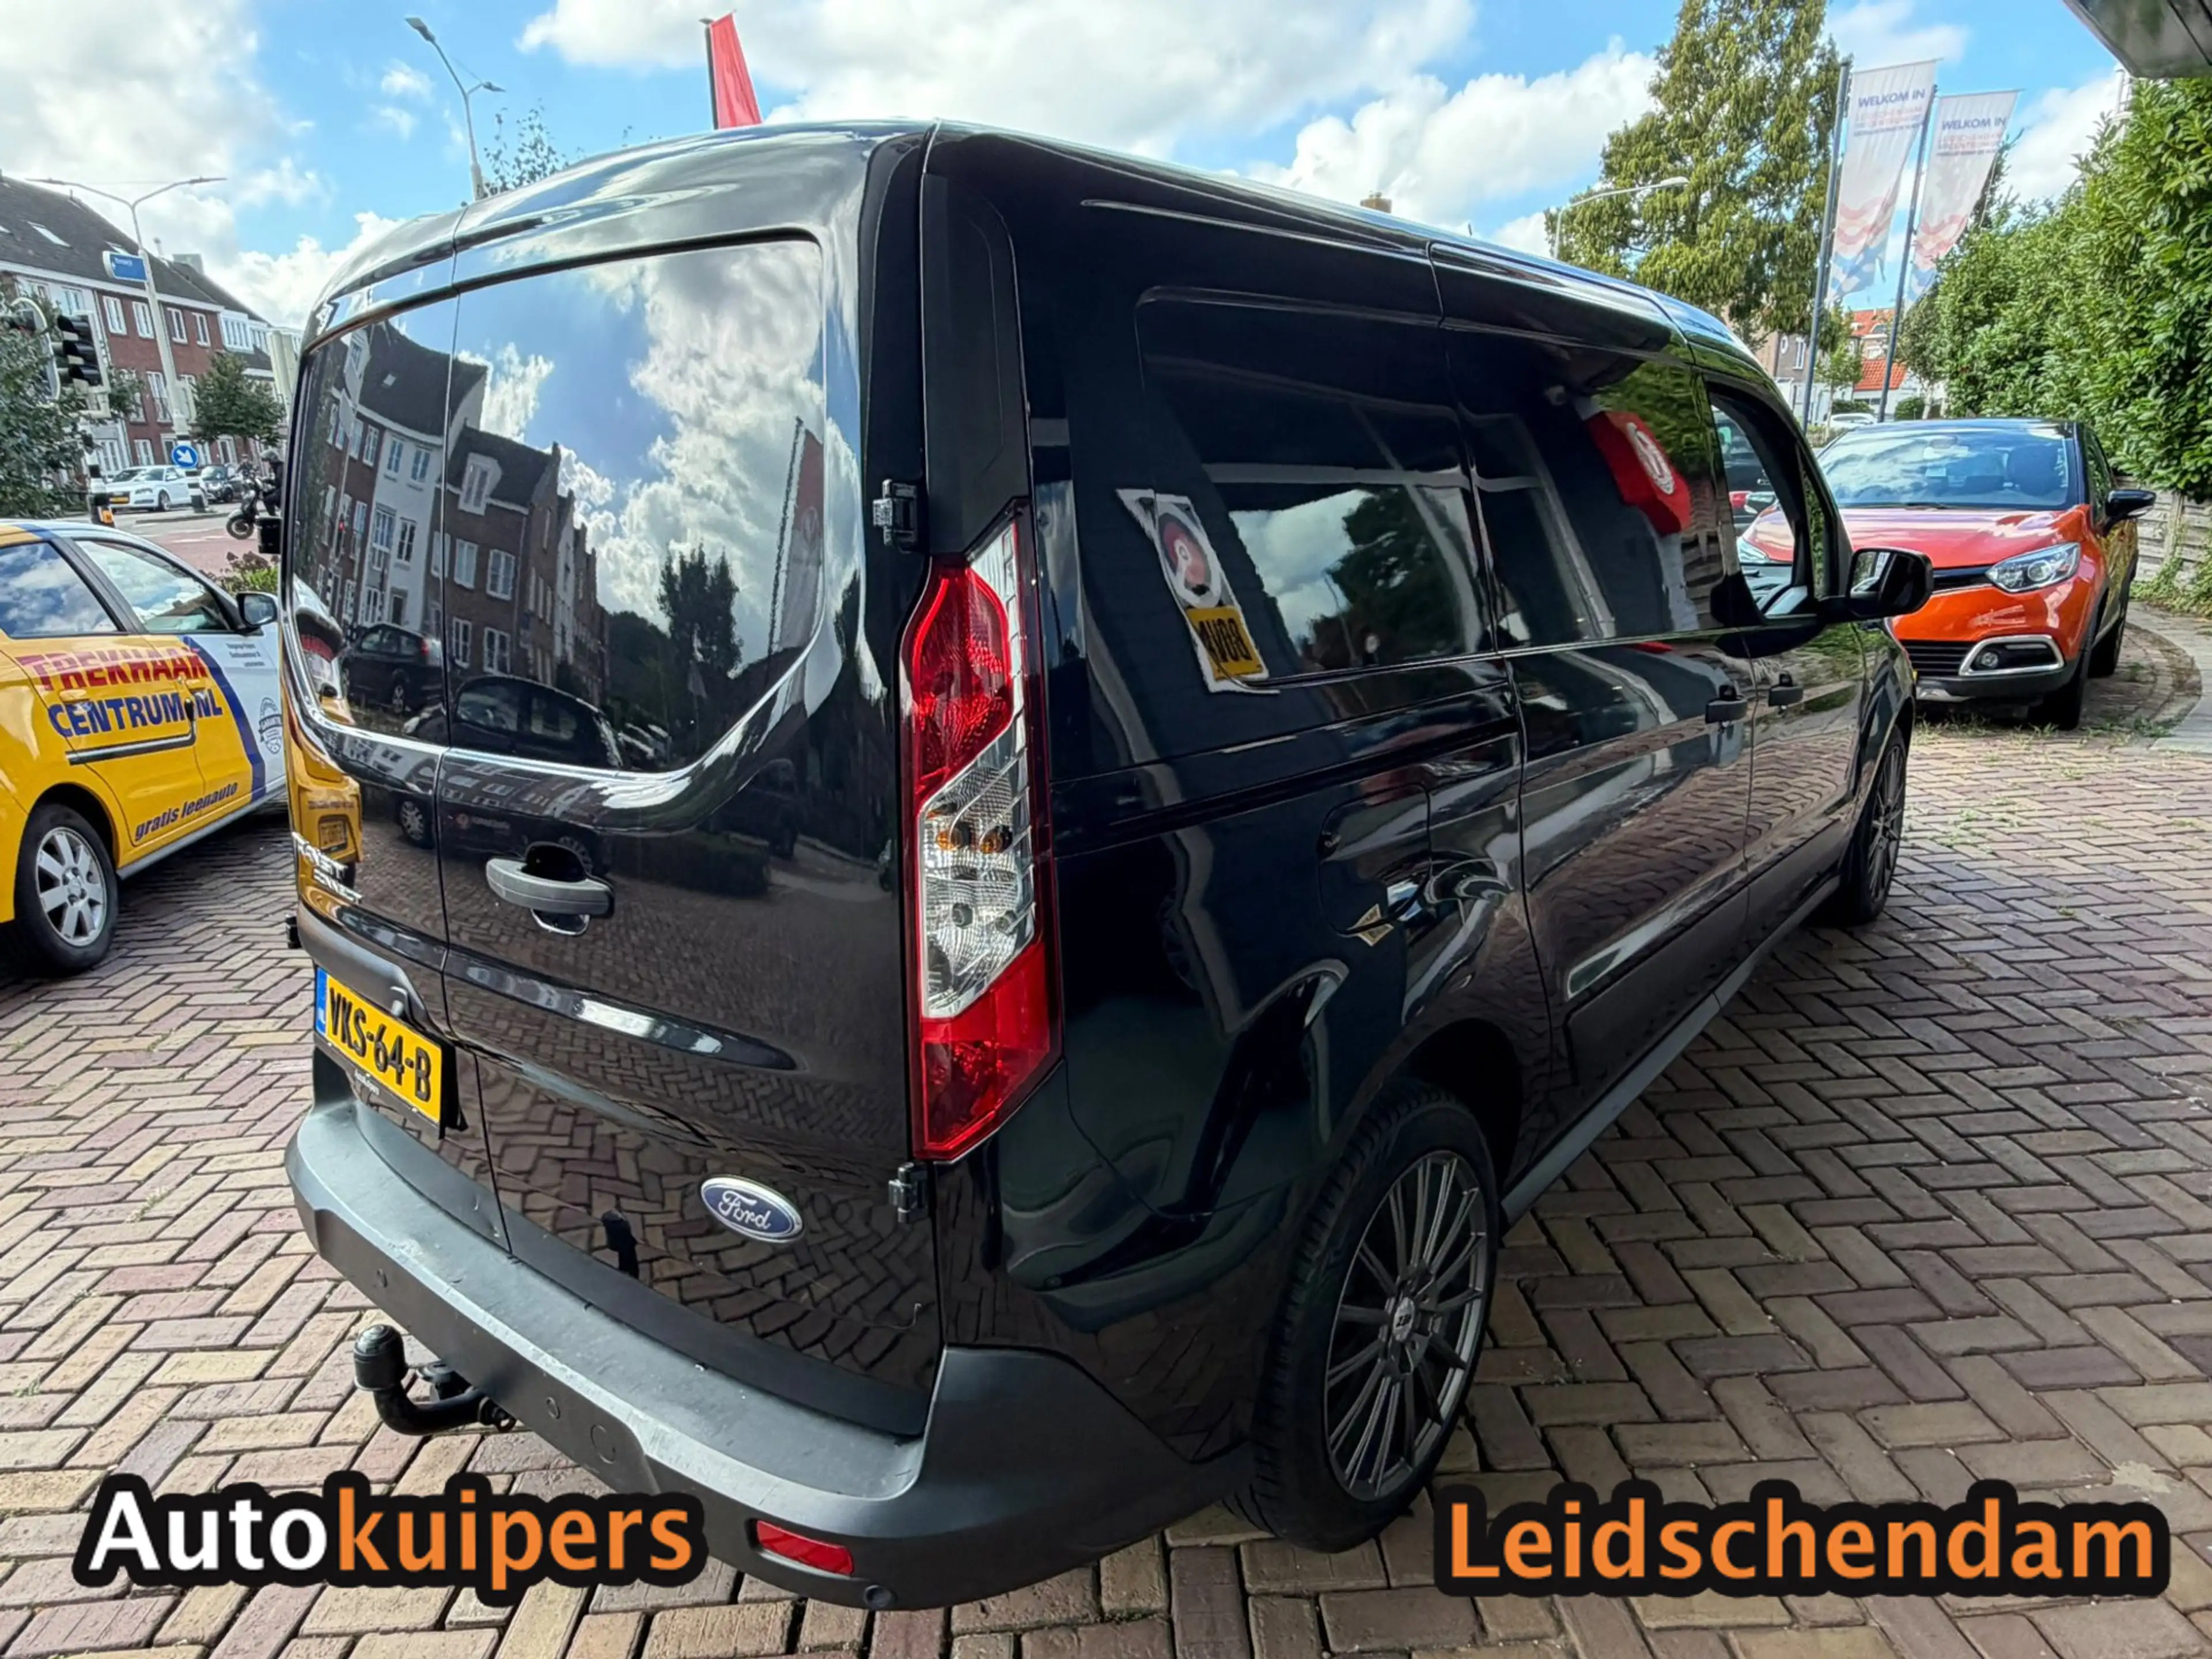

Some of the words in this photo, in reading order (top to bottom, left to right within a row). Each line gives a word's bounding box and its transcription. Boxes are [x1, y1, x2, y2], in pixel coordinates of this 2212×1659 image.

[1858, 92, 1908, 107] WELKOM
[1912, 89, 1925, 100] IN
[1942, 118, 1991, 130] WELKOM
[1994, 117, 2007, 126] IN
[15, 647, 209, 691] TREKHAAK
[135, 808, 179, 842] gratis
[181, 782, 238, 819] leenauto
[329, 986, 432, 1103] VKS-64-B
[718, 1190, 772, 1230] Ford
